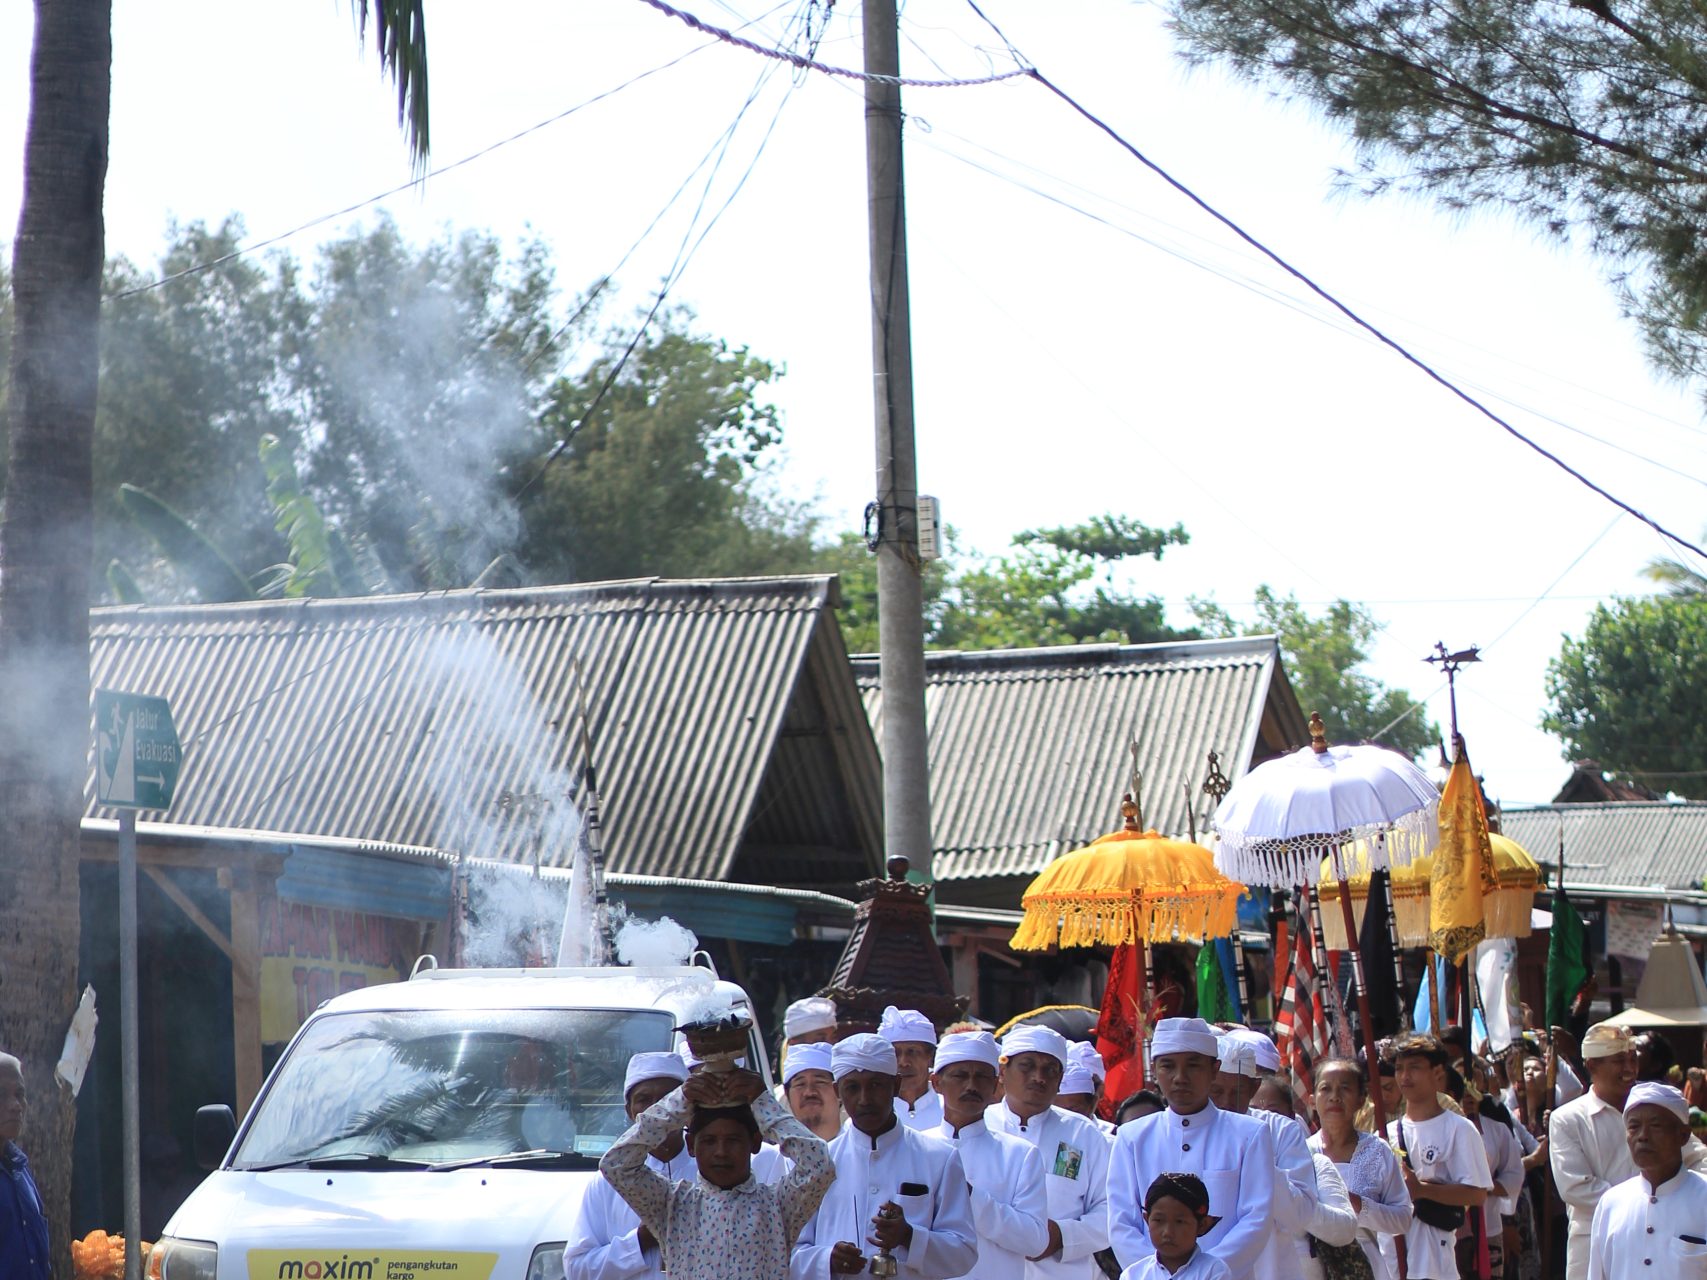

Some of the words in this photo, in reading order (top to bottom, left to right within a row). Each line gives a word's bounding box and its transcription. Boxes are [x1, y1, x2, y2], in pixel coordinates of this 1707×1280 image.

[136, 708, 158, 731] Jalur
[136, 740, 176, 763] Evakuasi
[279, 1255, 373, 1280] maxim
[387, 1270, 415, 1280] kargo
[388, 1260, 458, 1271] pengangkutan
